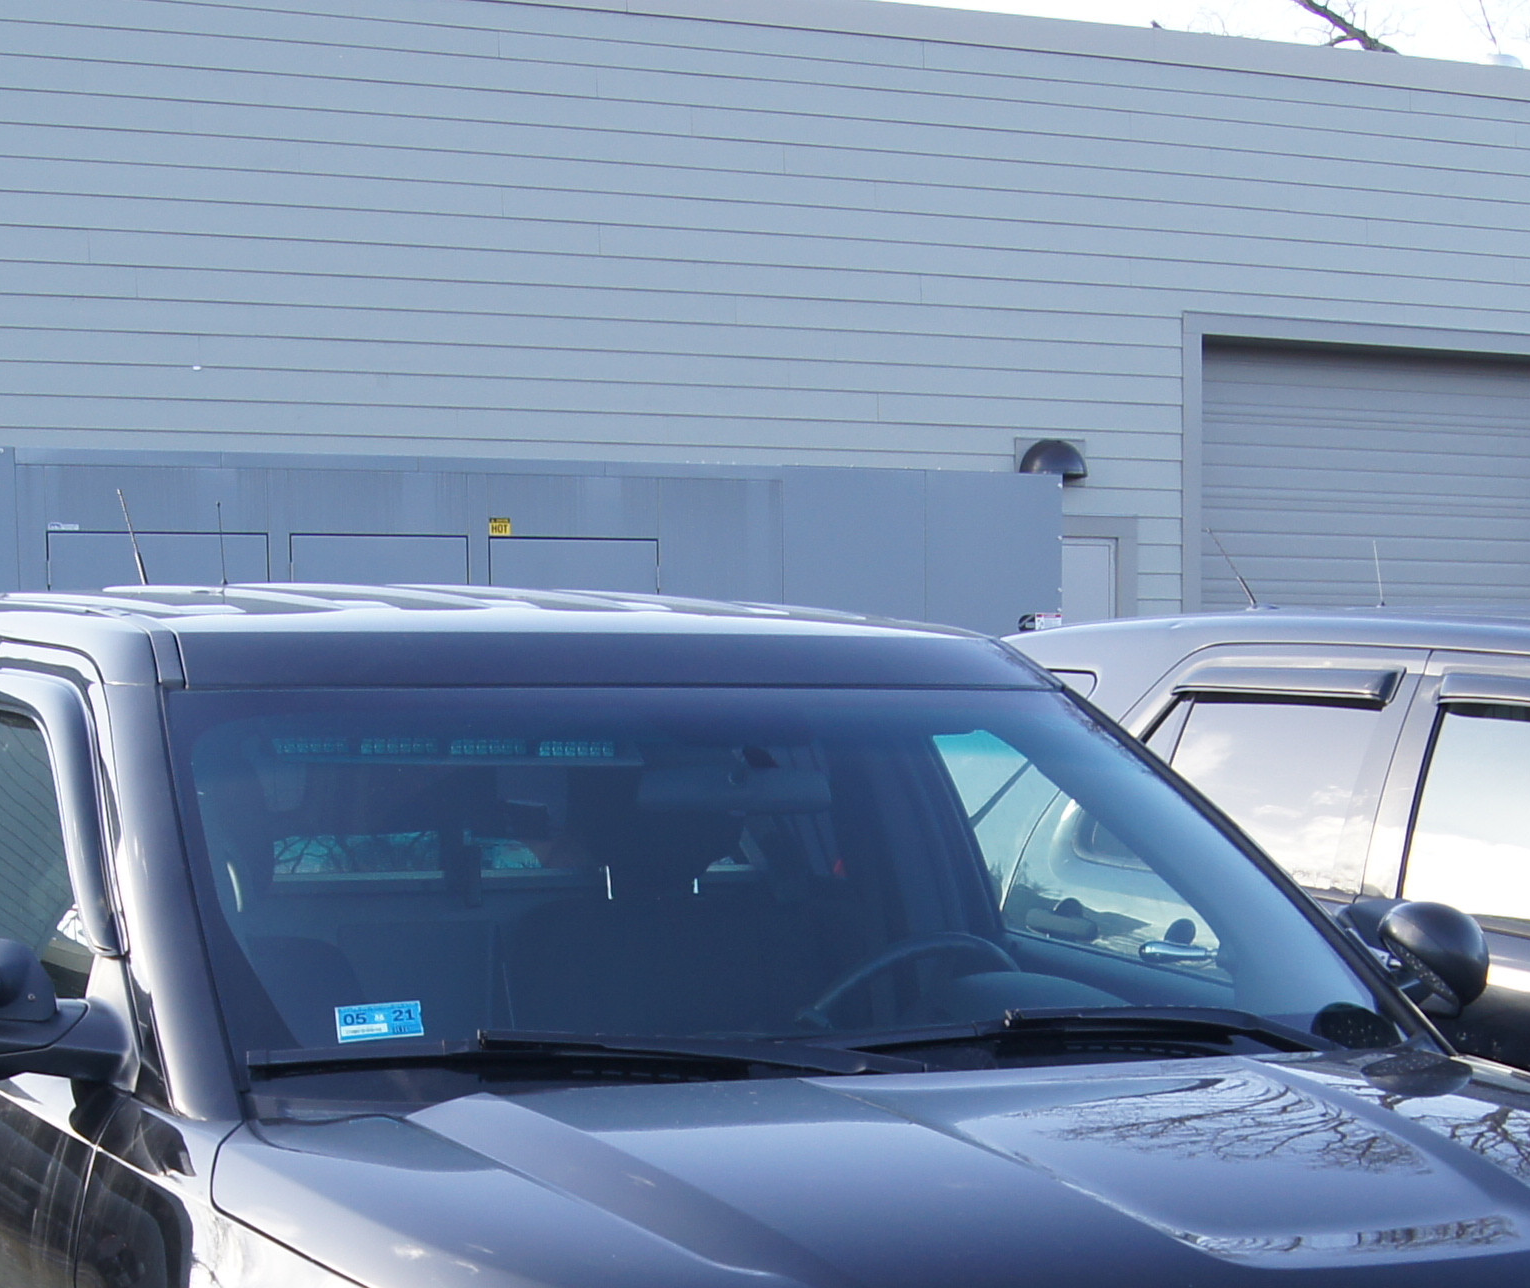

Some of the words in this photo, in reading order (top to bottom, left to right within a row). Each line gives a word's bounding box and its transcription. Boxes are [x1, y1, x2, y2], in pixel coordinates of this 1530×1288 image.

[491, 524, 508, 534] HOT
[343, 1013, 367, 1026] 05
[392, 1009, 416, 1022] 21
